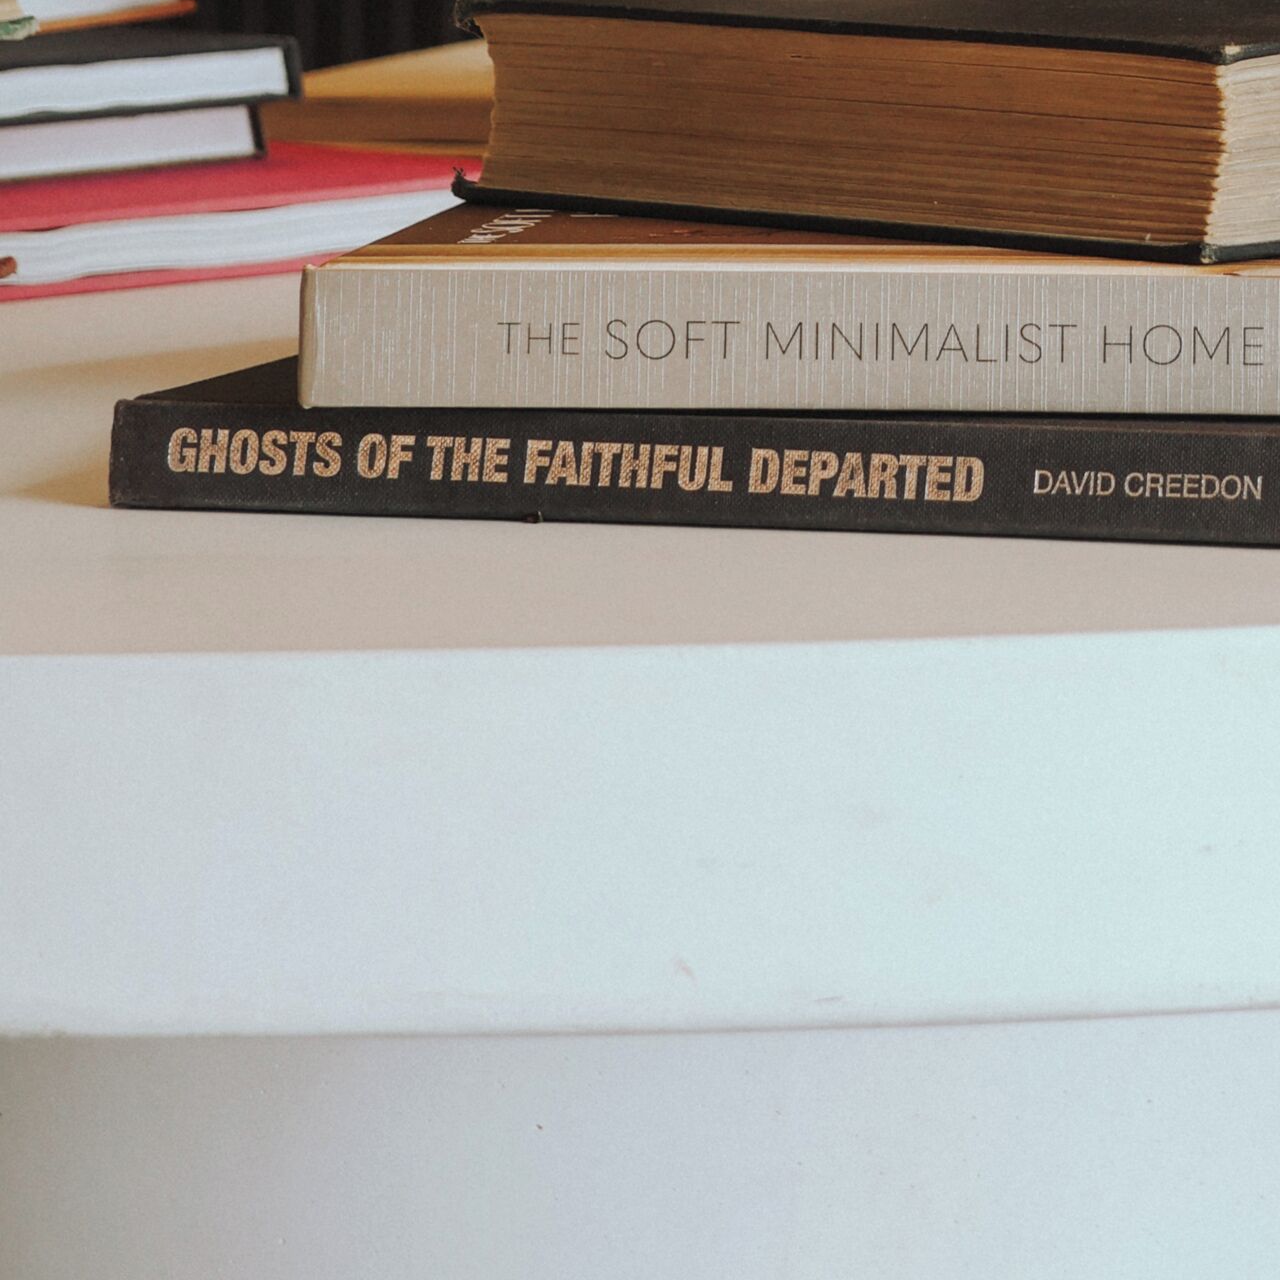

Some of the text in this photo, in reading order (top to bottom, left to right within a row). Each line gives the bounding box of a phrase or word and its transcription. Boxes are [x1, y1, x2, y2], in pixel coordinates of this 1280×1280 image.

[497, 319, 1265, 367] THE SOFT MINIMALIST HOME
[166, 427, 985, 502] GHOSTS OF THE FAITHFUL DEPARTED
[1032, 469, 1263, 501] DAVID CREEDON
